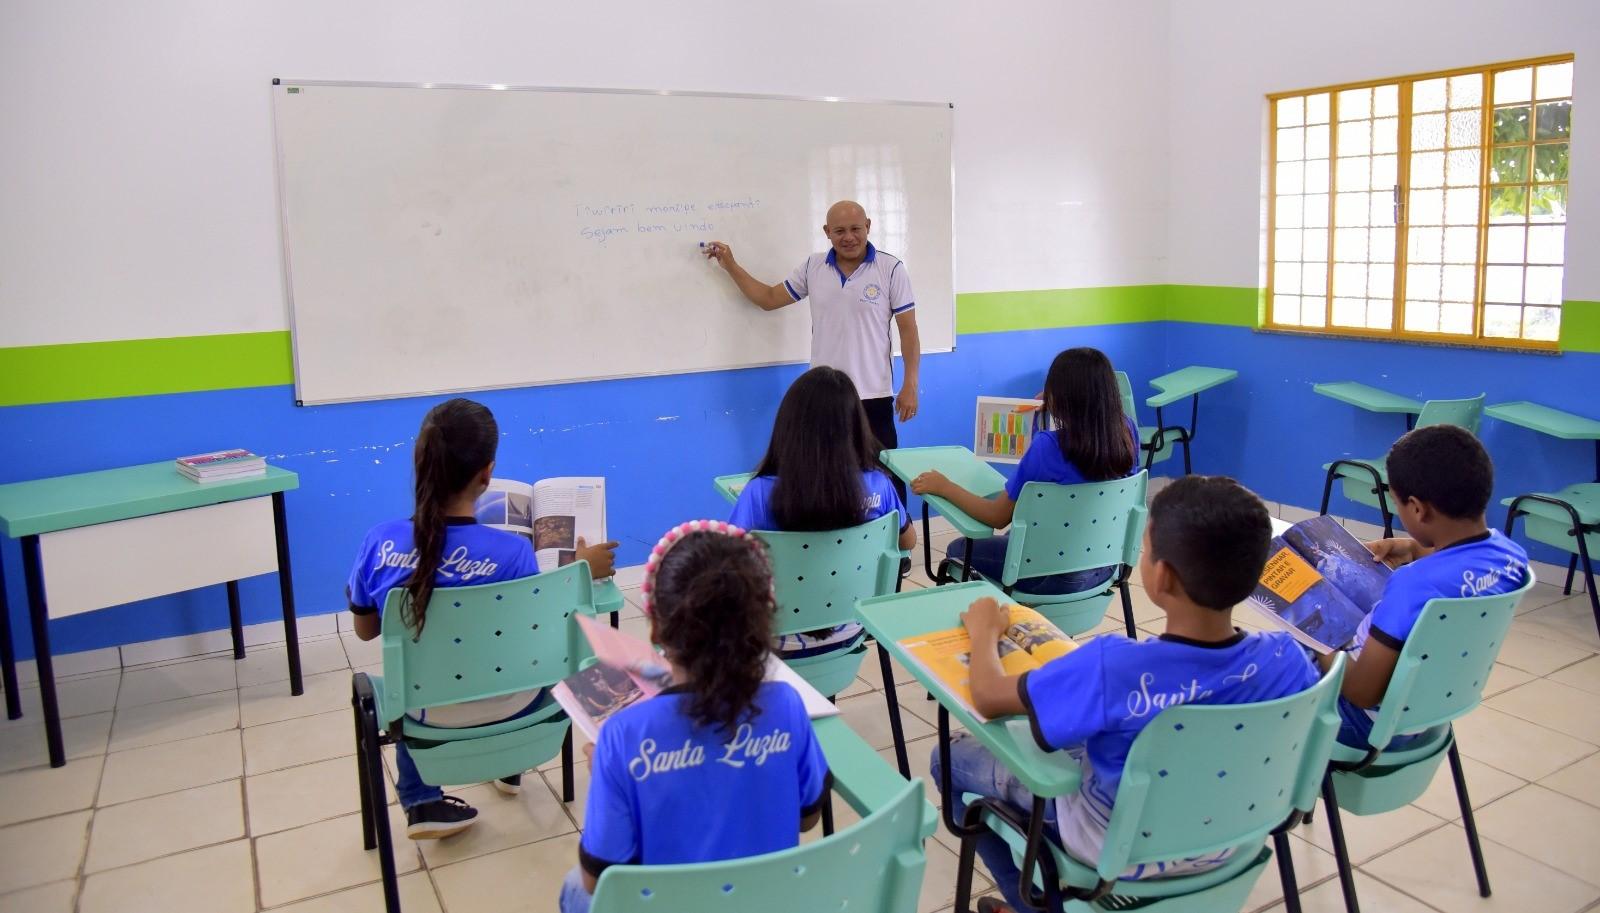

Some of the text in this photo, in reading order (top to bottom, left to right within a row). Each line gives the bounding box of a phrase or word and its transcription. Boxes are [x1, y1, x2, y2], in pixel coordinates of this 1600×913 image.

[637, 220, 667, 233] bem
[436, 545, 499, 581] Luzia
[1263, 564, 1285, 584] PINTAR
[1271, 568, 1296, 589] GRAVAR
[629, 723, 791, 782] Santa Luzia
